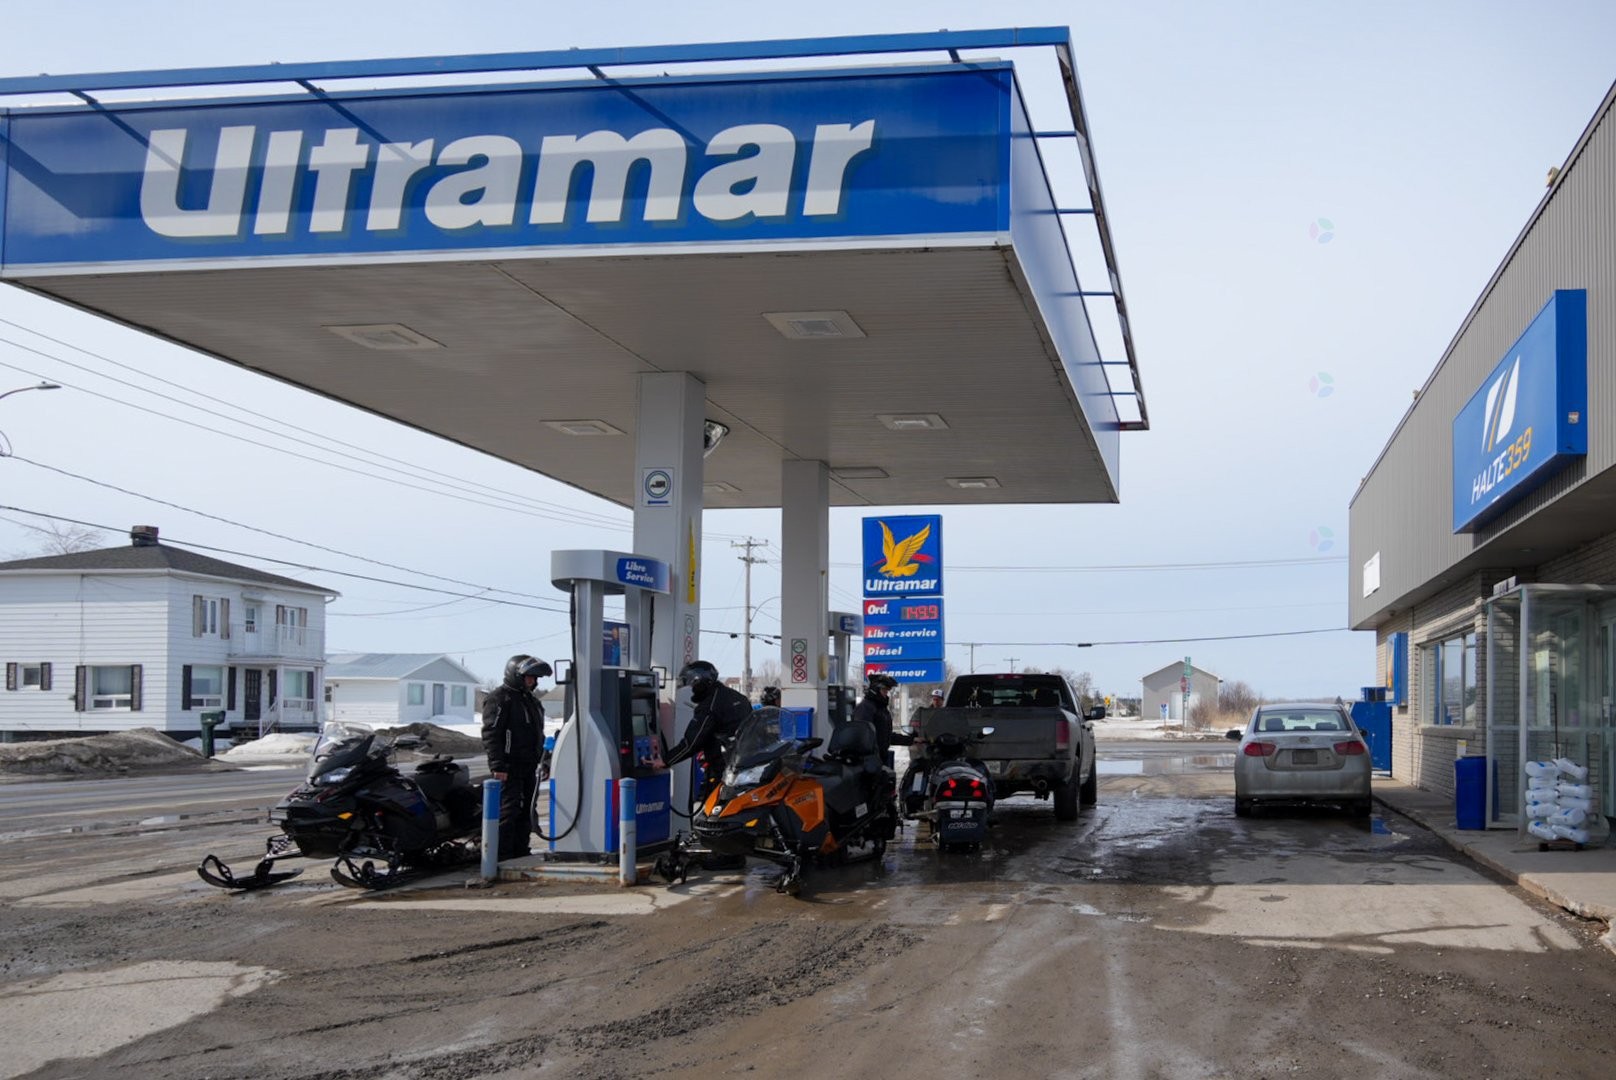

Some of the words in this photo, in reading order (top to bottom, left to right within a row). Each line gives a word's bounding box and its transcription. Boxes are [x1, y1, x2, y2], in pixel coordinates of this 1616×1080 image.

[139, 119, 876, 238] Ultramar
[625, 561, 647, 572] Libre
[625, 571, 655, 583] Service
[866, 579, 938, 591] Ultramar
[867, 604, 890, 615] Ord.
[867, 628, 937, 638] Libre-service
[867, 646, 903, 656] Diesel
